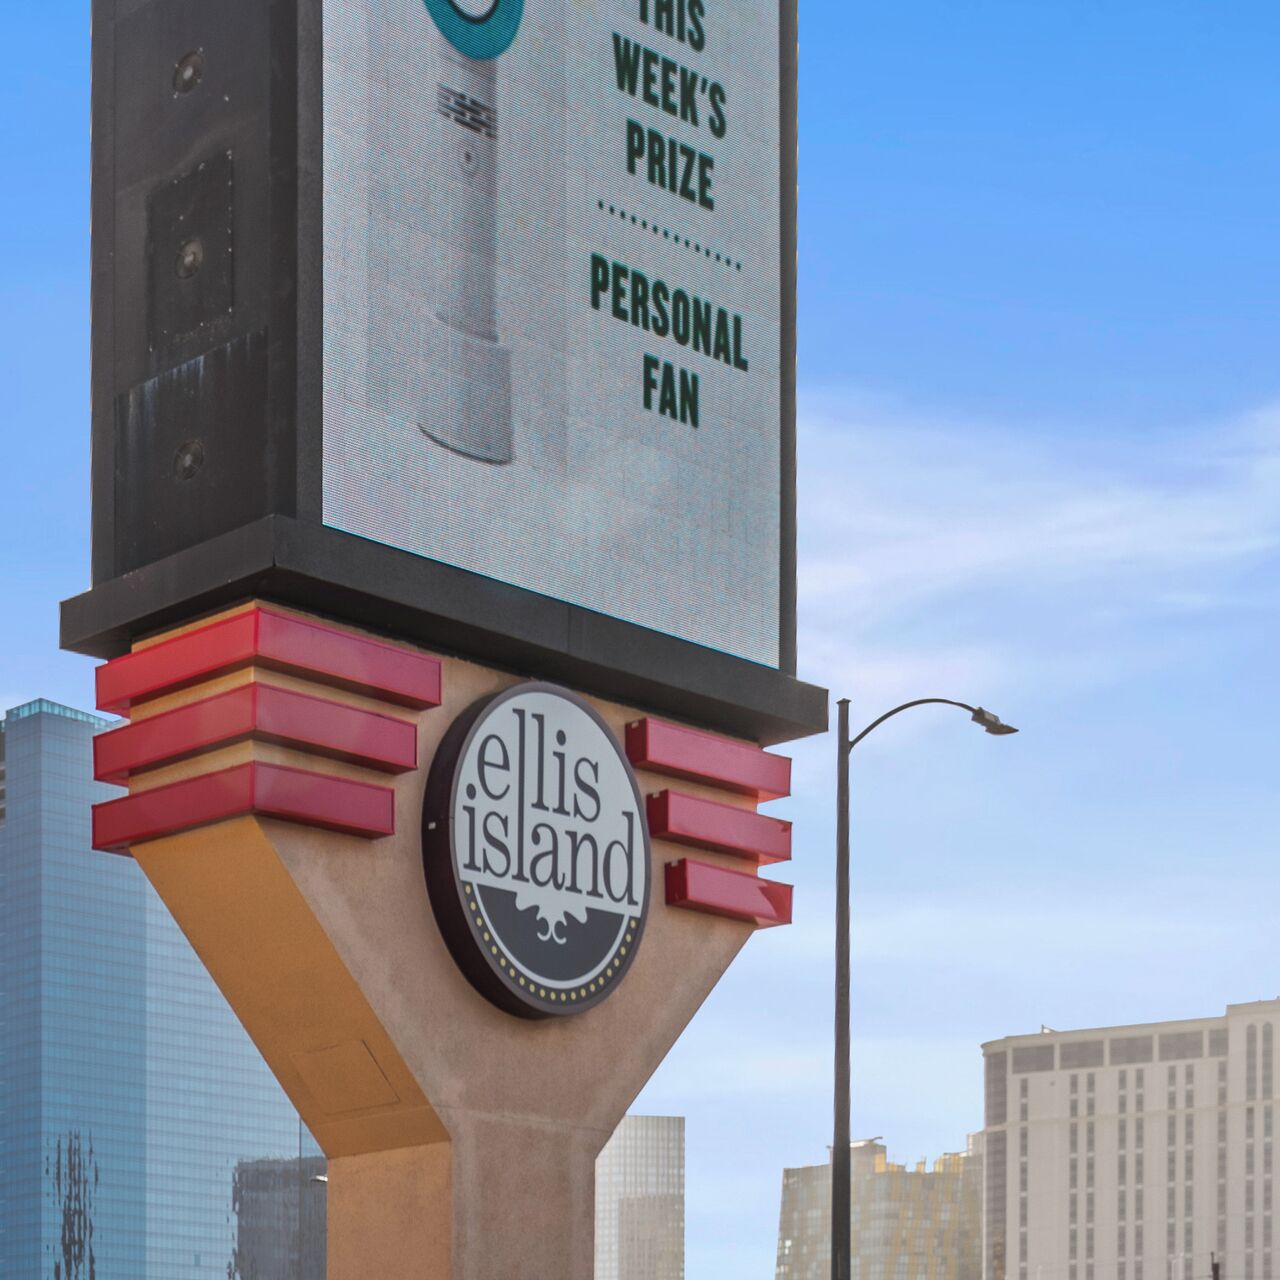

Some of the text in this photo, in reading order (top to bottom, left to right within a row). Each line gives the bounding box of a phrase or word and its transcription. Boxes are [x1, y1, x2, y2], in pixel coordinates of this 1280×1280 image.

[612, 32, 727, 139] WEEK'S
[626, 117, 715, 211] PRIZE
[590, 253, 749, 371] PERSONAL
[642, 353, 701, 428] FAN
[476, 708, 601, 823] ellis
[462, 783, 639, 906] island
